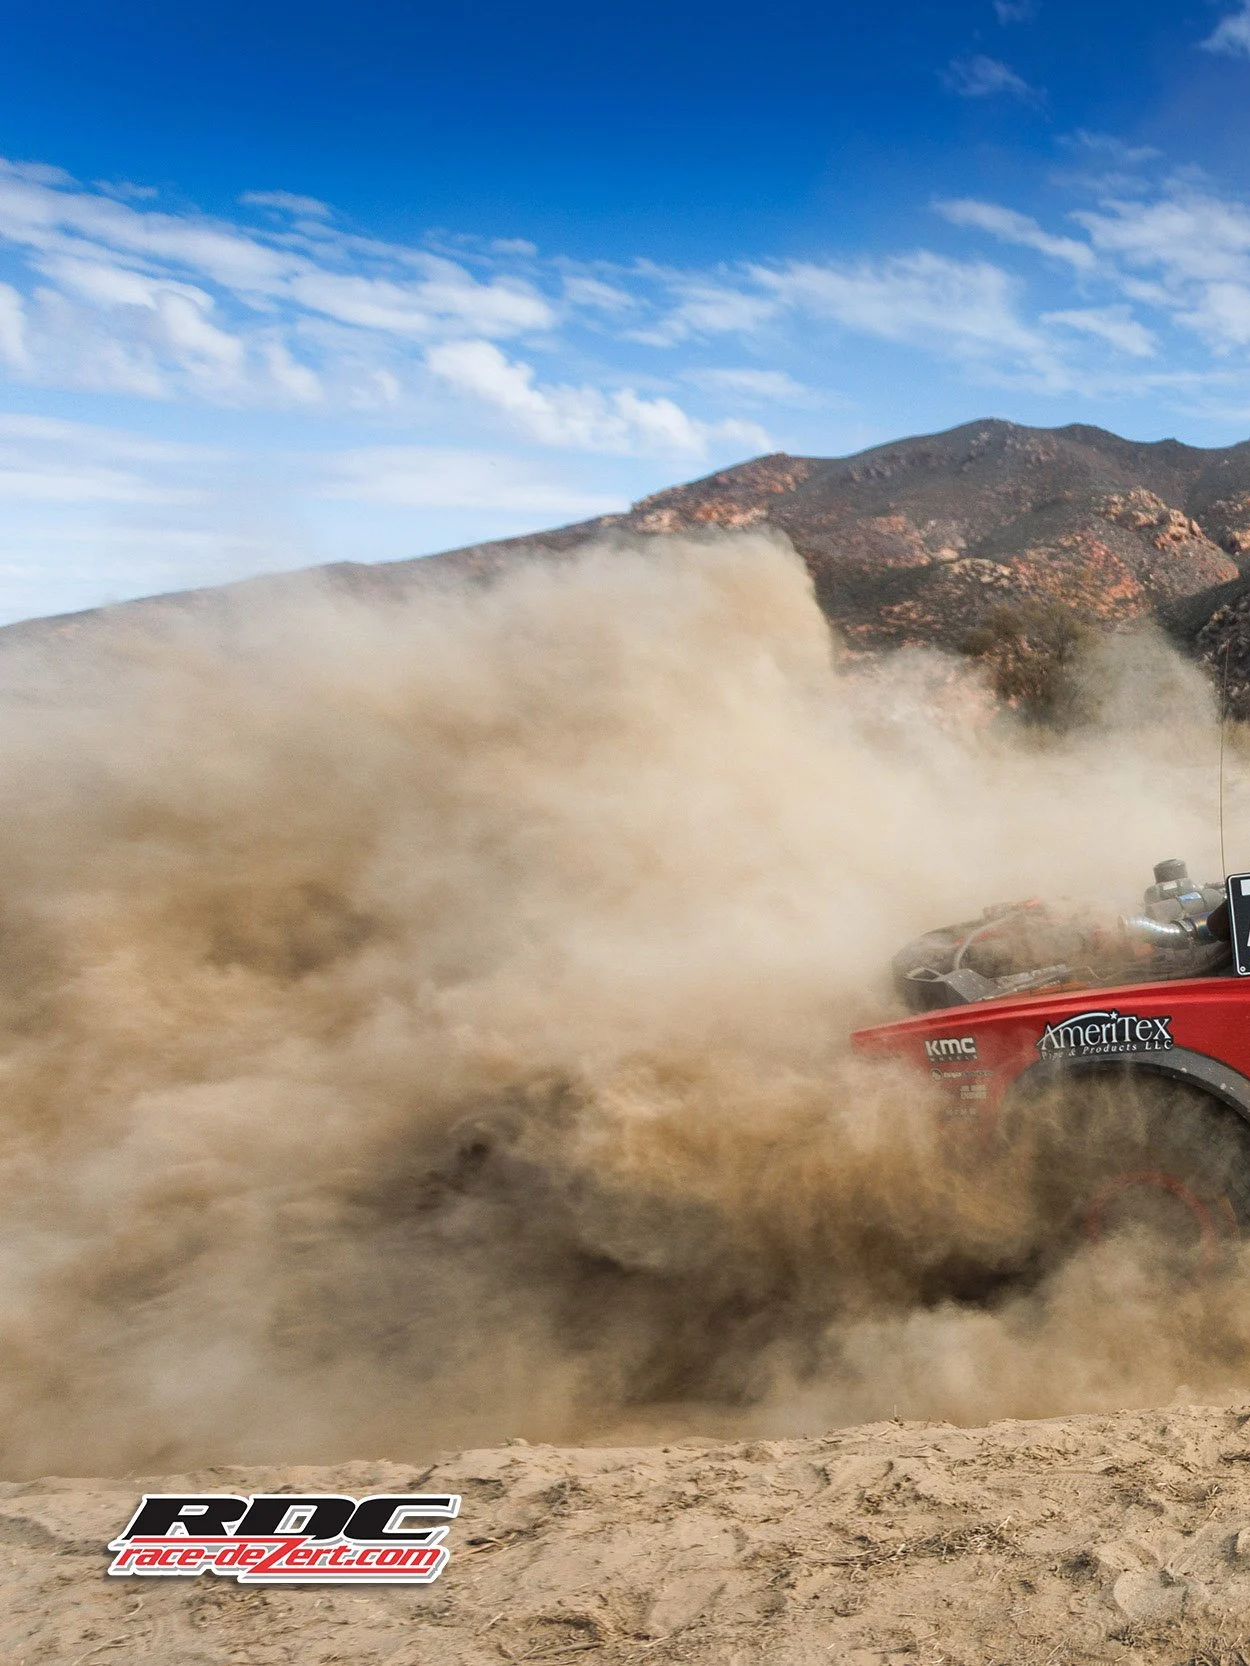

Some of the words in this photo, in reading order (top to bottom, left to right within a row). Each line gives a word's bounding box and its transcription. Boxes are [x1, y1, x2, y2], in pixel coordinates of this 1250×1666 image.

[1038, 1012, 1172, 1050] AmeriTex
[1082, 1043, 1137, 1055] Products
[1145, 1040, 1174, 1050] LLC
